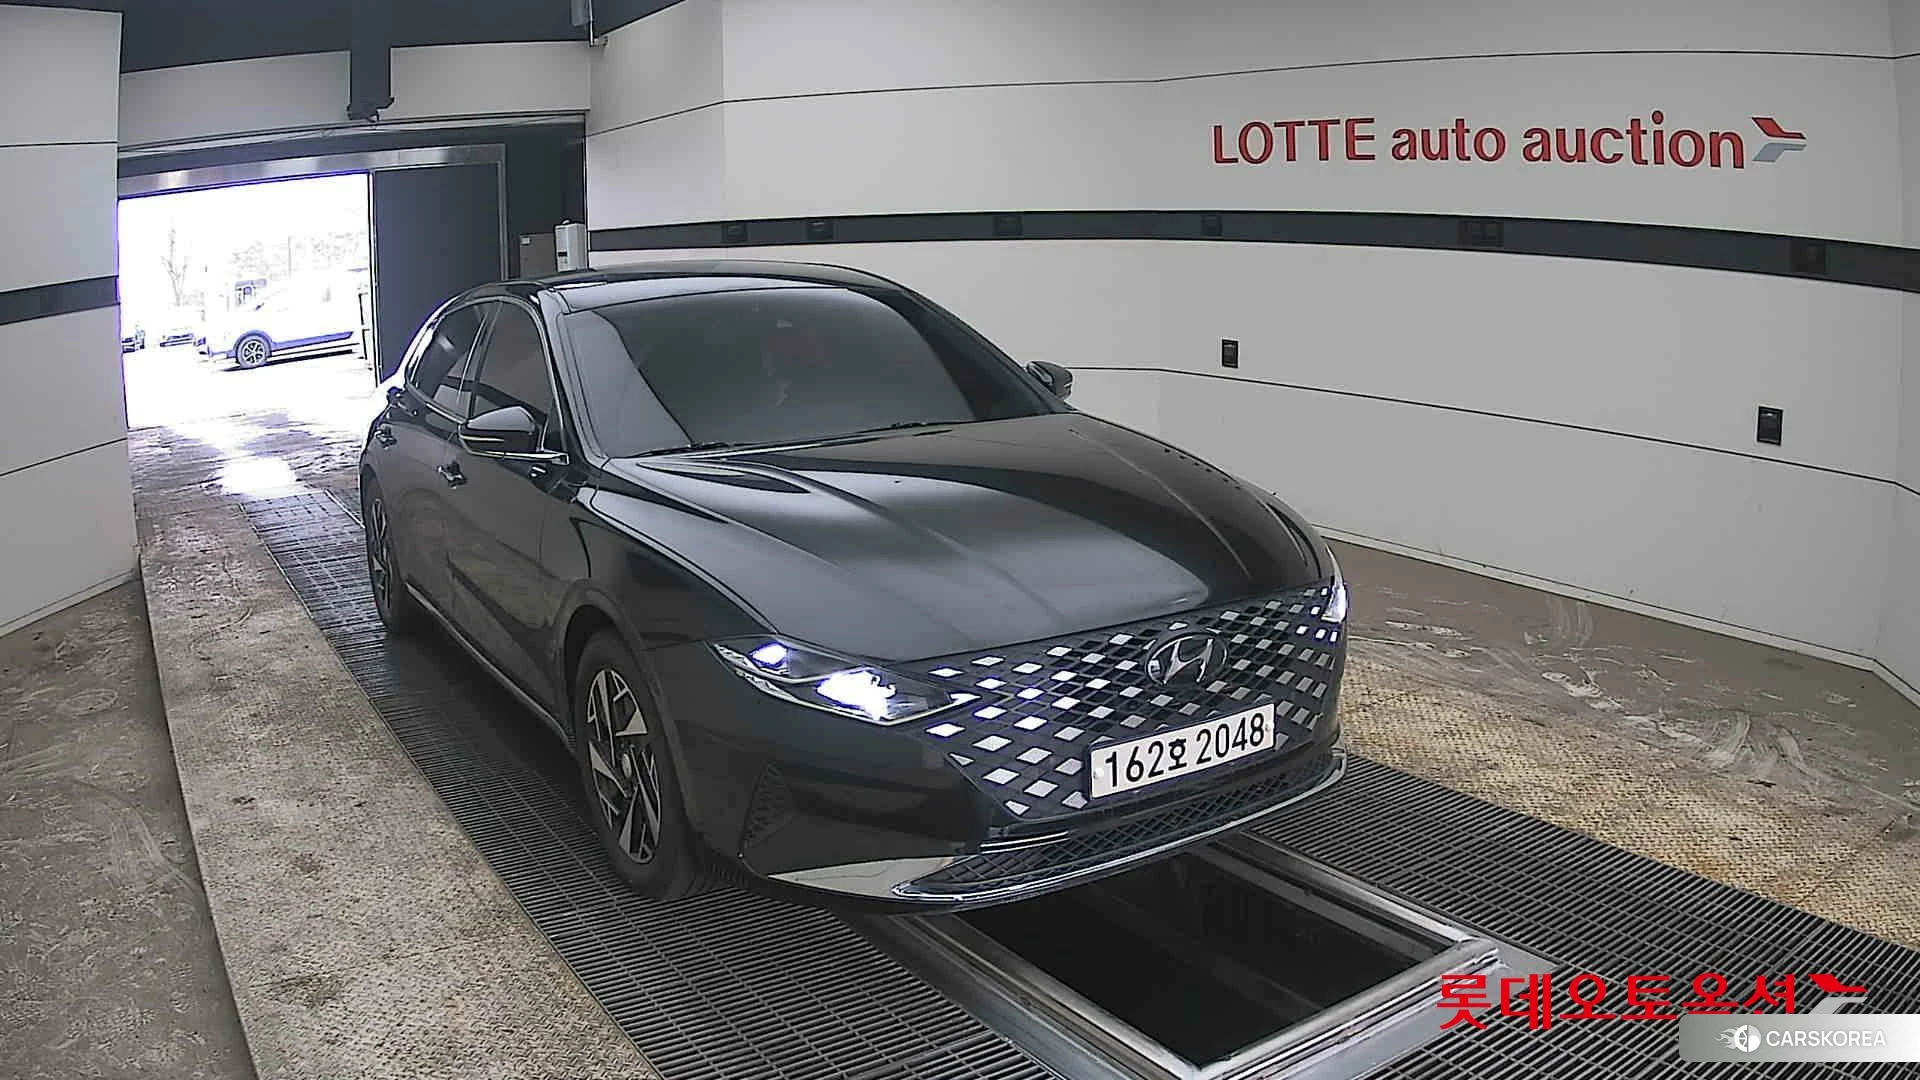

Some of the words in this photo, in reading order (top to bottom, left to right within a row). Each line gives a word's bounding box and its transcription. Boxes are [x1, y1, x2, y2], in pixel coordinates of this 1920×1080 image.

[1213, 117, 1377, 165] LOTTE
[1391, 117, 1507, 163] auto
[1521, 110, 1745, 169] auction
[1105, 737, 1187, 787] 162호
[1195, 712, 1265, 765] 2048
